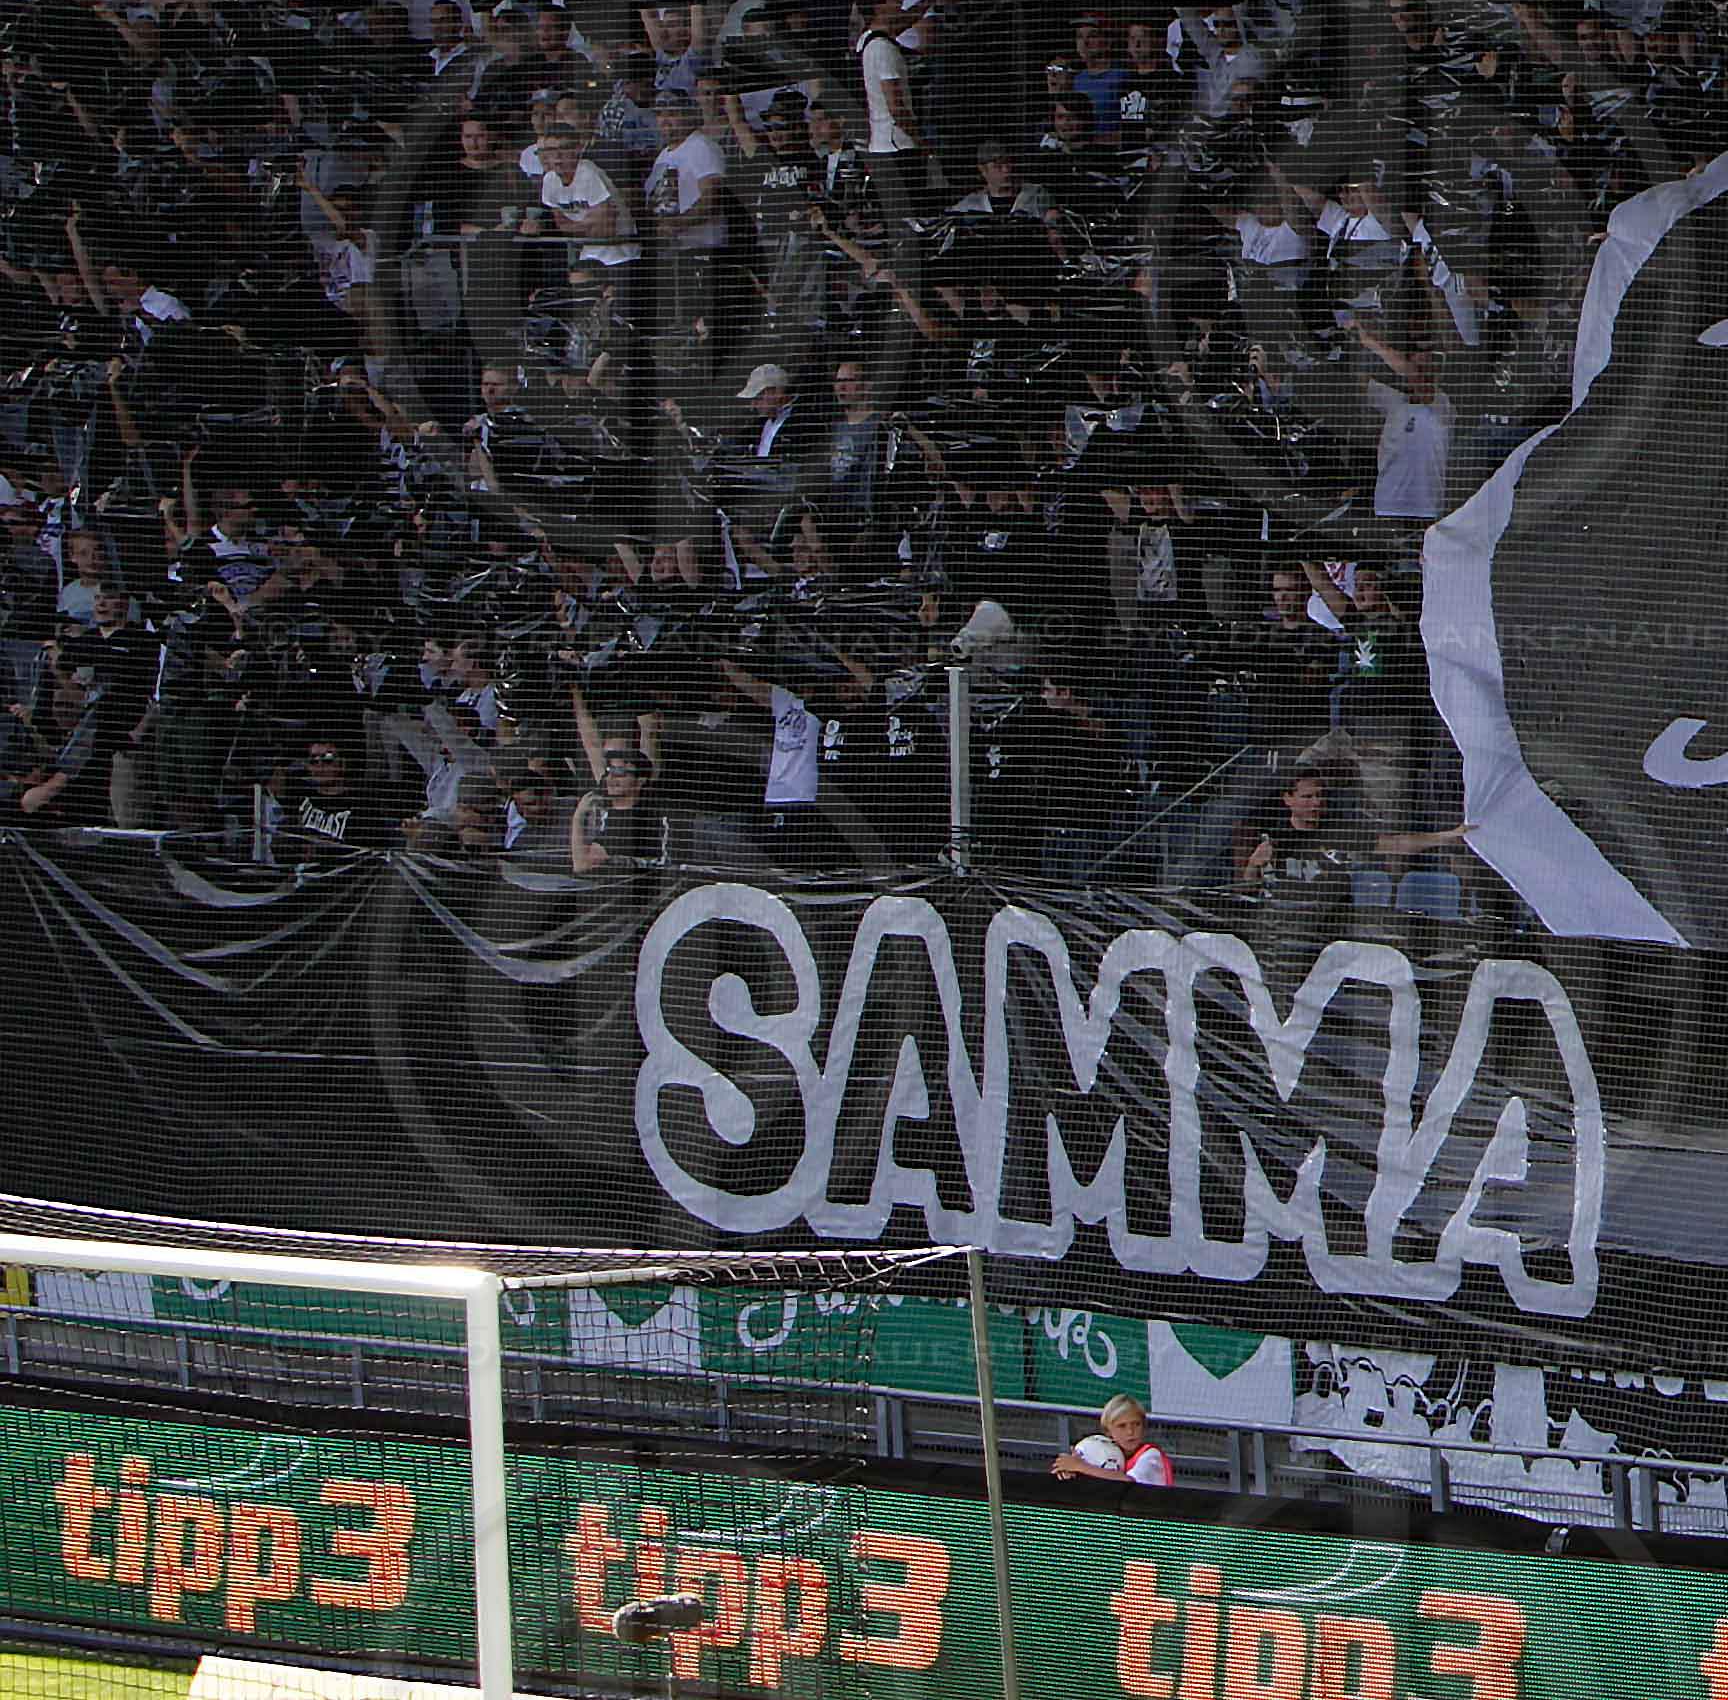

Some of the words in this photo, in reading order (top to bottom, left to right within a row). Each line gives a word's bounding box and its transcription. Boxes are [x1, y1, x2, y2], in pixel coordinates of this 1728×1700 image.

[636, 882, 1605, 1318] SAMMA
[54, 1451, 416, 1634] tipp3
[566, 1501, 950, 1690] tipp3
